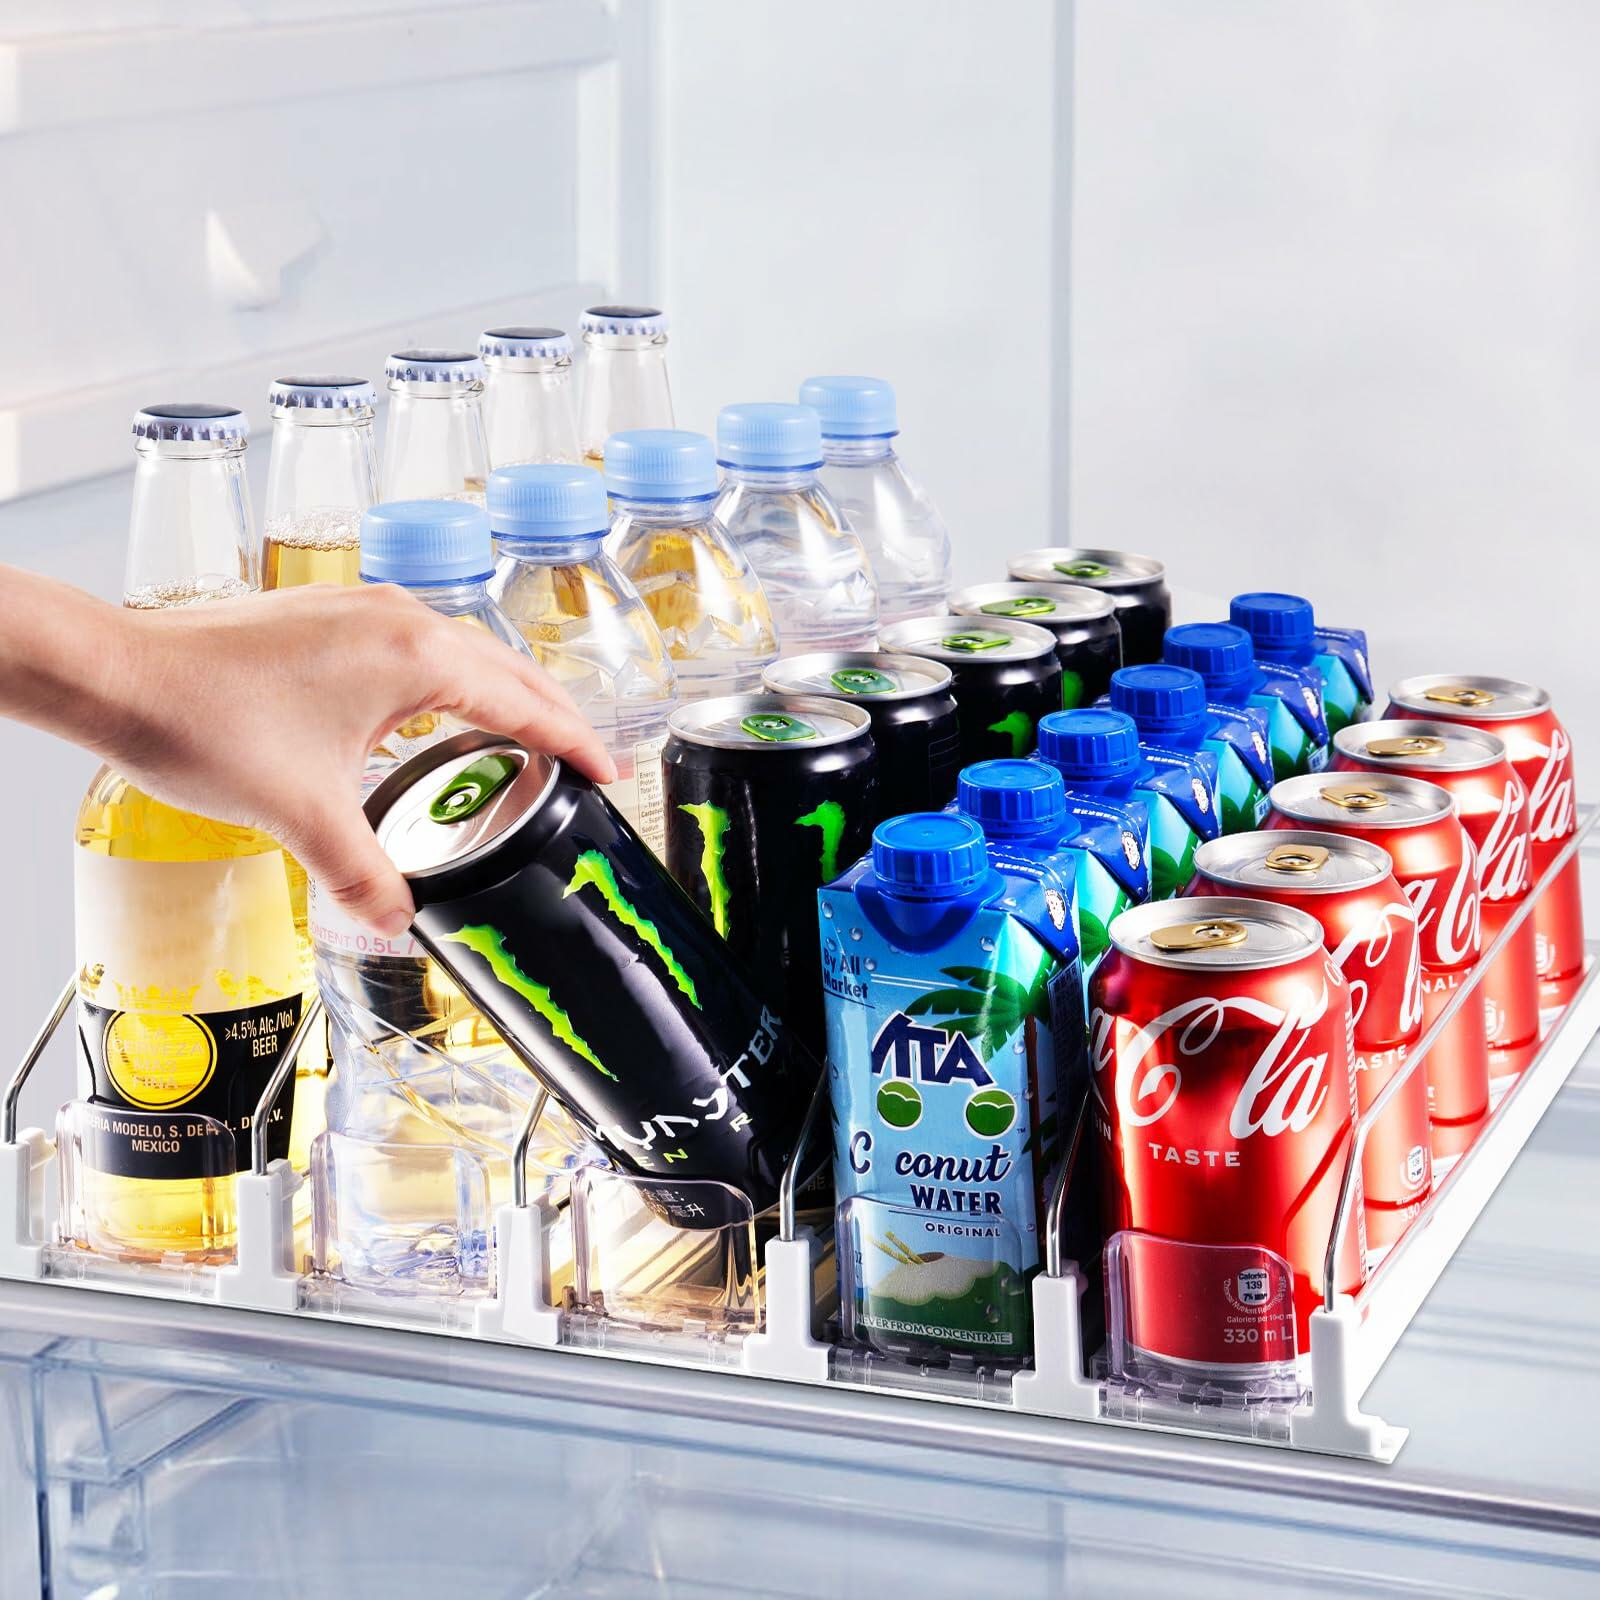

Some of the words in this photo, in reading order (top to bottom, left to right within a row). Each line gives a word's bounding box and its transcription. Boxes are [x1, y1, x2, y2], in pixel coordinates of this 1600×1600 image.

[310, 920, 350, 946] ONTENT
[355, 935, 401, 955] 0.5L
[823, 947, 837, 974] By
[840, 954, 860, 976] All
[823, 967, 868, 999] Market
[252, 1034, 278, 1058] BEER
[1355, 1044, 1408, 1073] ASTE
[112, 1121, 165, 1140] MODELO,
[169, 1127, 182, 1138] S.
[187, 1123, 205, 1137] DE
[131, 1139, 180, 1154] MEXICO
[1148, 1141, 1241, 1168] TASTE
[910, 1183, 1002, 1215] WATER
[925, 1222, 1001, 1238] ORIGINAL
[1246, 1280, 1263, 1290] 139
[891, 1319, 925, 1335] FROM
[925, 1325, 1011, 1344] CONCENTRATE
[1223, 1327, 1259, 1344] 330
